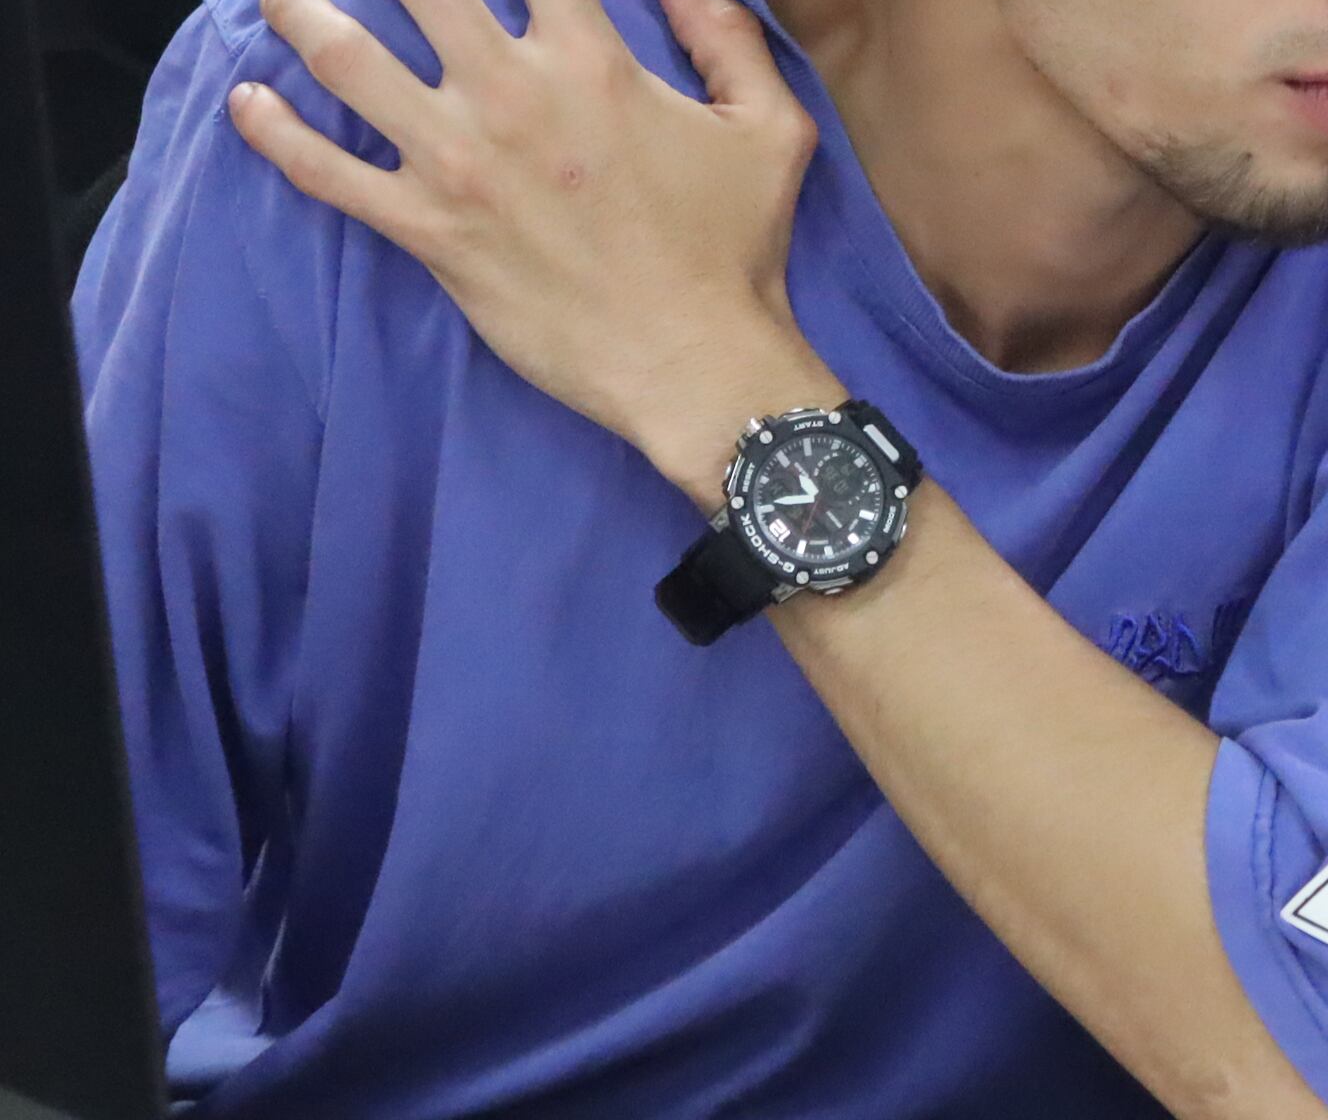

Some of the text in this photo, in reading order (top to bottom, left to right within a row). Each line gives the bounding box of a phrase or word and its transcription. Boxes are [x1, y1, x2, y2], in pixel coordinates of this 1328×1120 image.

[769, 519, 791, 542] 12
[741, 513, 795, 573] G-SHOCK
[813, 562, 849, 575] ADJUST
